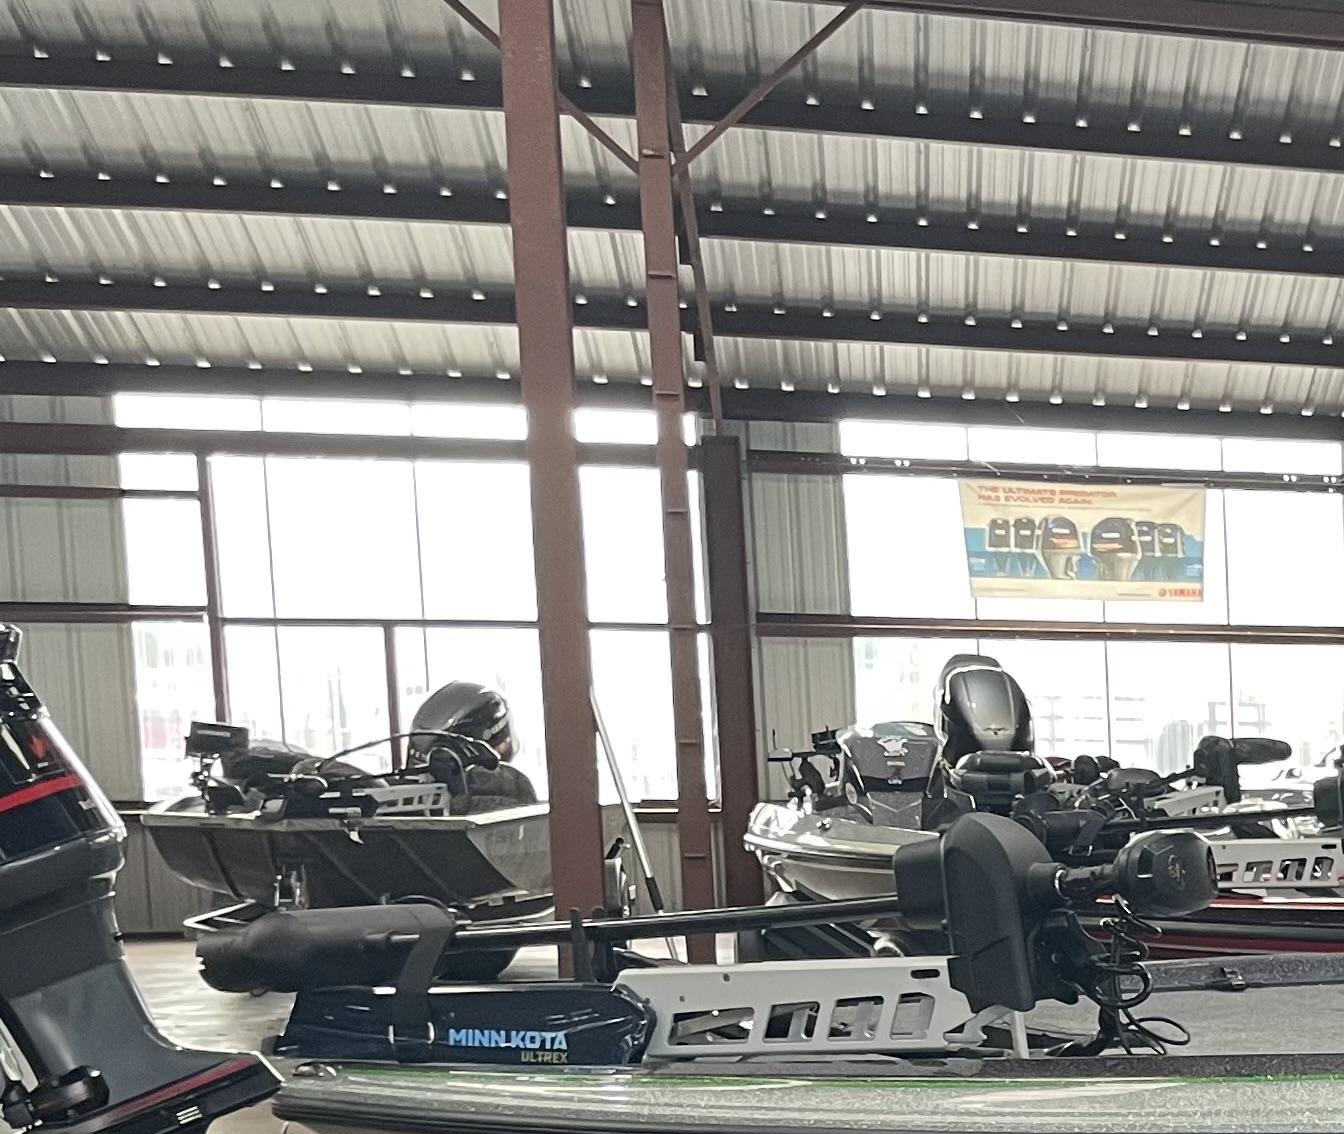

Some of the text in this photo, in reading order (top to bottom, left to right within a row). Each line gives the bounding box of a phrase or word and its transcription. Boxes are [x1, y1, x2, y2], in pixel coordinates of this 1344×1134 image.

[978, 485, 1000, 494] THE
[977, 494, 1001, 502] HAS
[1004, 495, 1055, 504] EVOLVED
[449, 1028, 568, 1050] MINN KOTA
[520, 1051, 568, 1064] ULTREX
